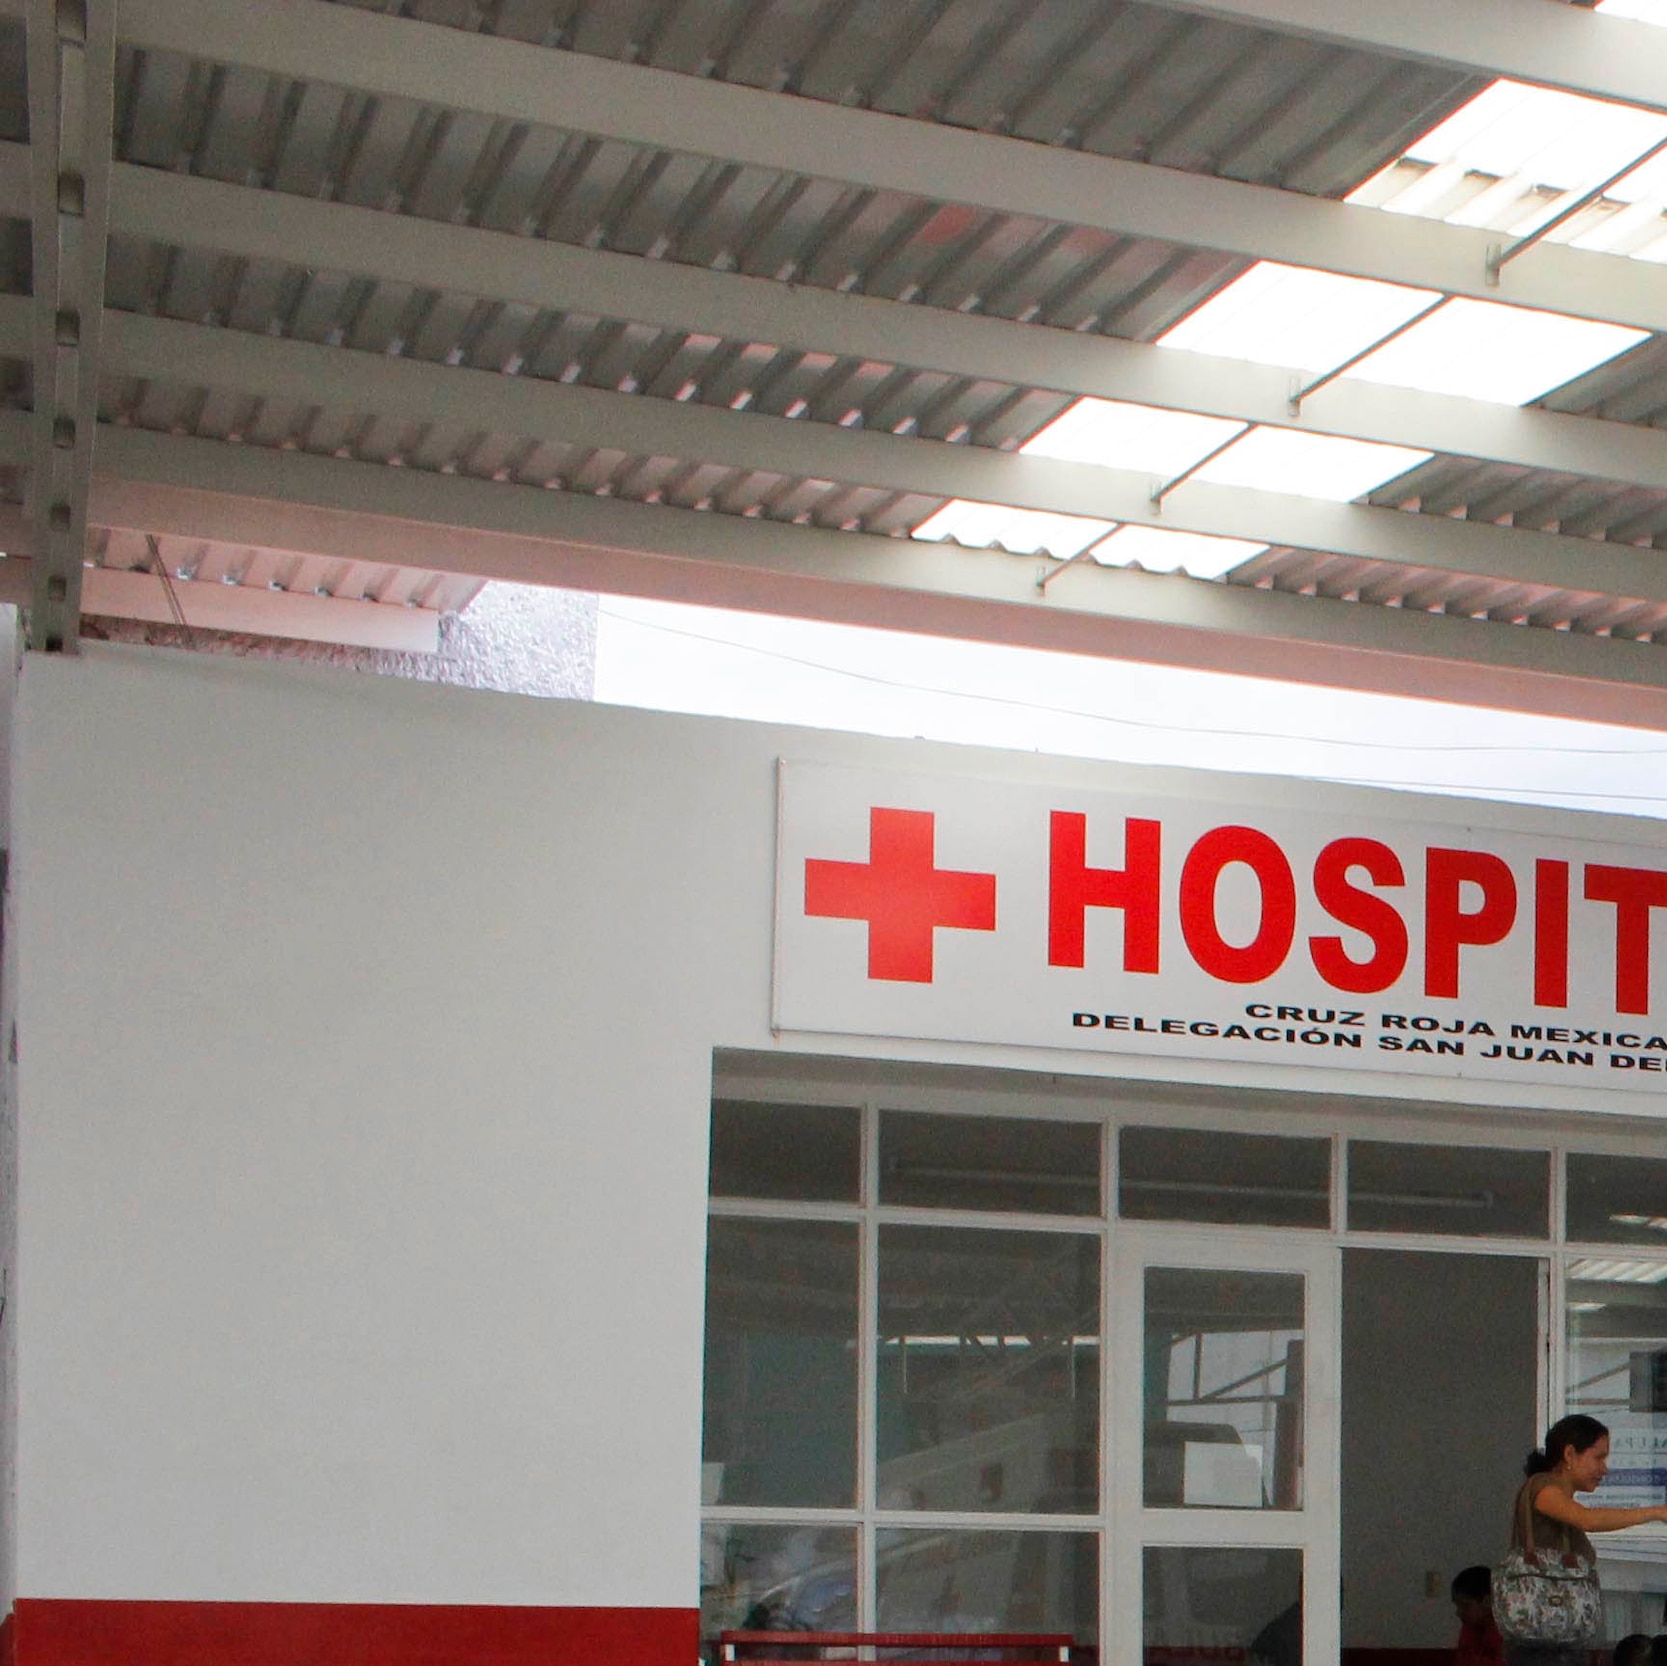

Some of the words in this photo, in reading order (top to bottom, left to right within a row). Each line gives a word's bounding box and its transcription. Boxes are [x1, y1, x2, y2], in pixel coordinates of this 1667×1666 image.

[1072, 1012, 1363, 1048] DELEGACIÓN
[1377, 1036, 1465, 1056] SAN
[1480, 1045, 1594, 1067] JUAN
[1245, 1004, 1365, 1026] CRUZ
[1381, 1013, 1496, 1036] ROJA
